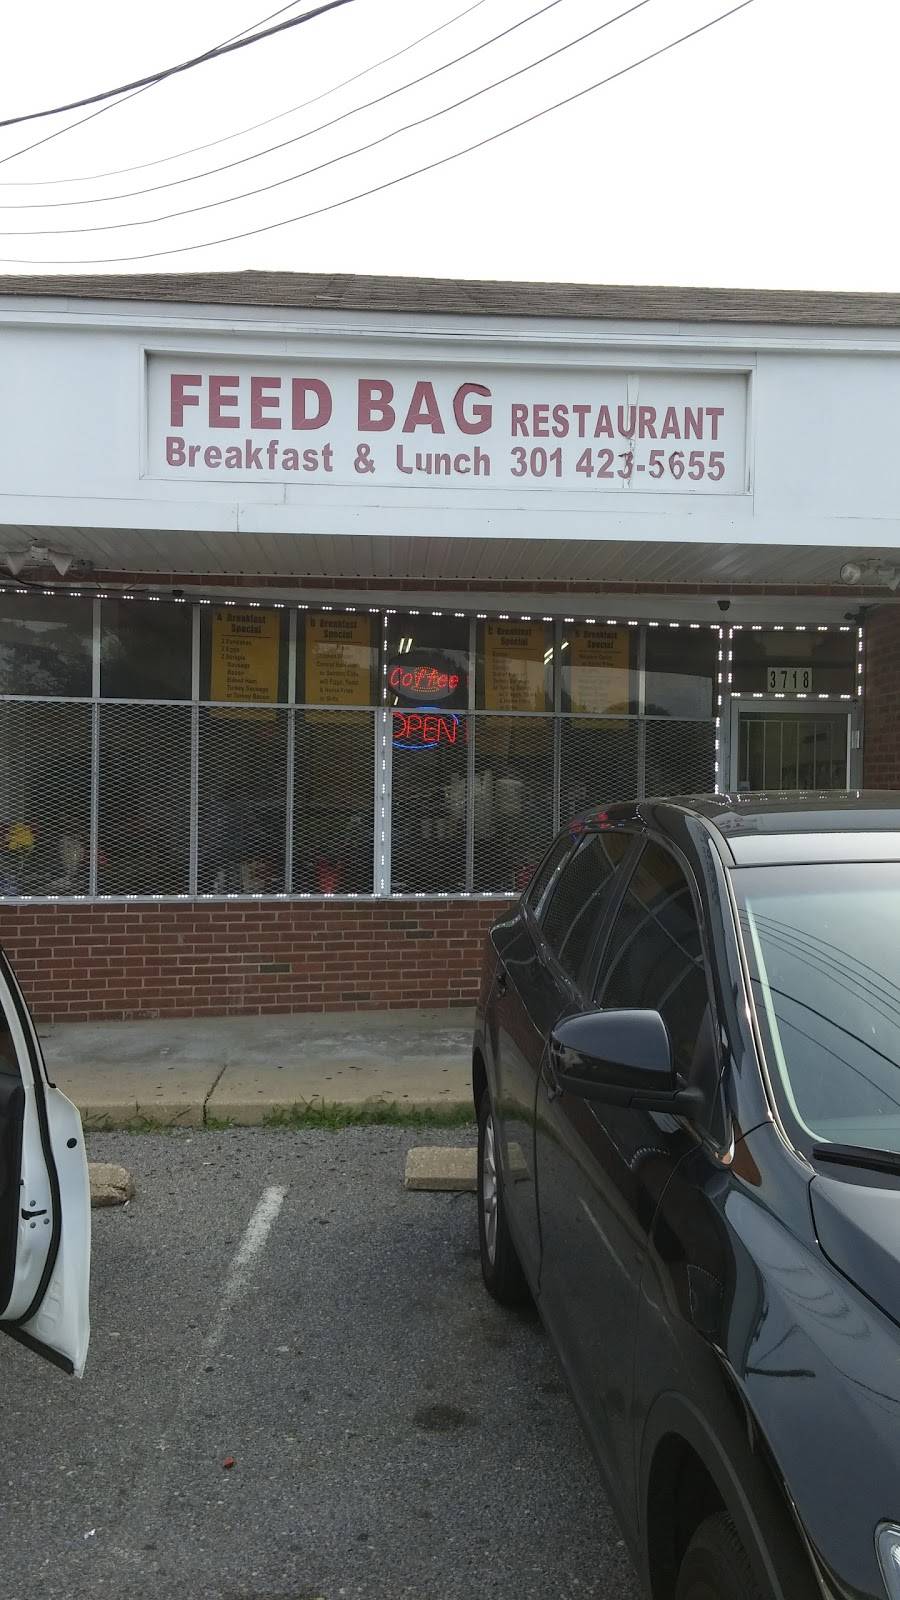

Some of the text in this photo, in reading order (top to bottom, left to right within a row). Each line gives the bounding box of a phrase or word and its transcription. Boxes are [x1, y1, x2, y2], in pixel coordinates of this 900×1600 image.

[170, 374, 725, 440] FEED BAG RESTAURANT
[166, 436, 725, 481] Breakfast & Lunch 301 423-5655
[226, 613, 266, 624] Breakfast
[231, 623, 262, 634] Special
[389, 666, 460, 690] Coffee
[770, 670, 809, 689] 3718
[391, 711, 458, 743] OPEN
